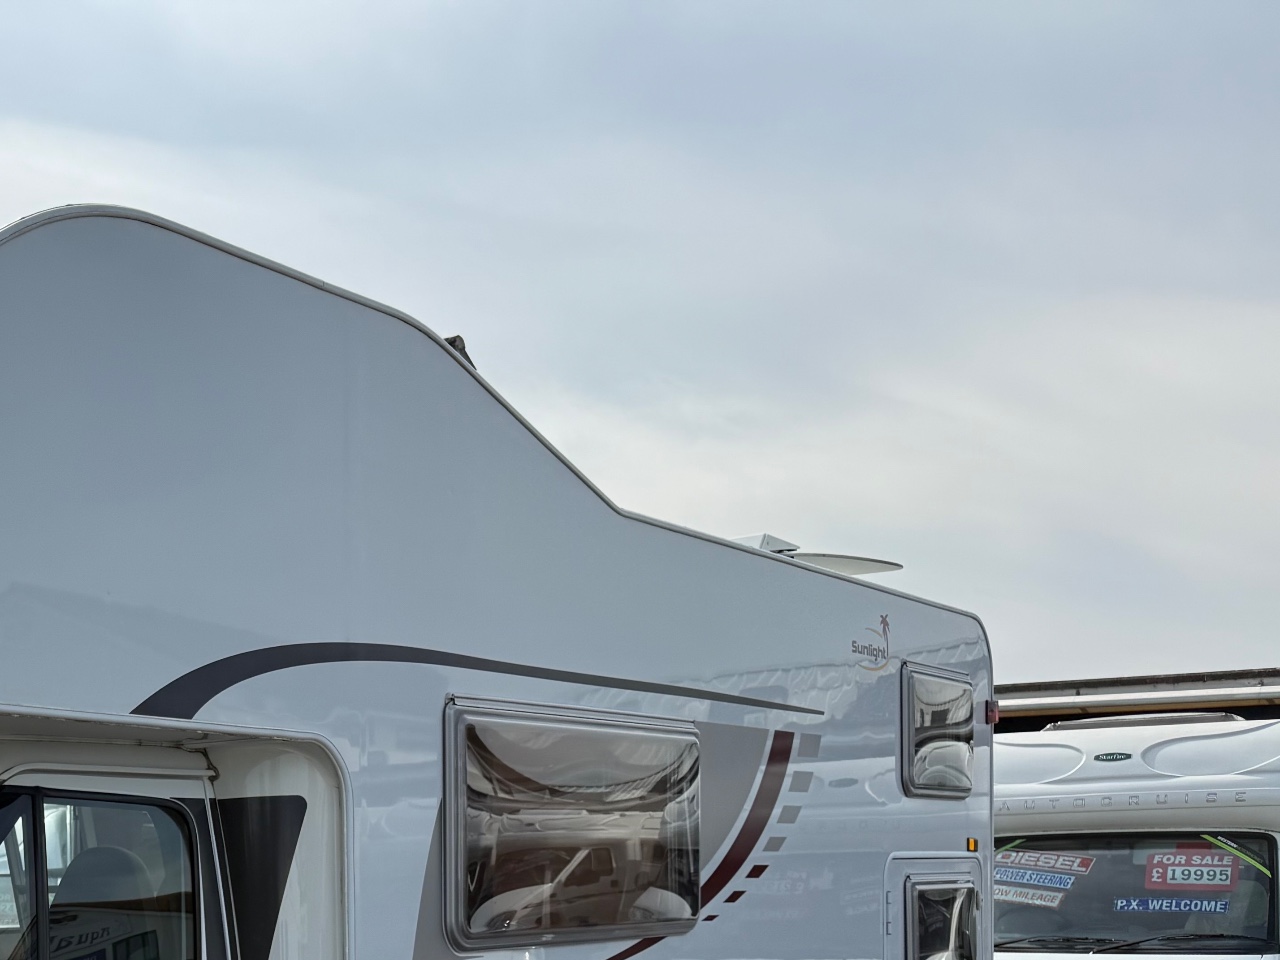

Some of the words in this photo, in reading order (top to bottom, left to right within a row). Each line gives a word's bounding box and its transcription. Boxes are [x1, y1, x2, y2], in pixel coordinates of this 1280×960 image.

[851, 639, 887, 662] Sunlight
[995, 850, 1087, 872] DIESEL
[1153, 854, 1187, 864] FOR
[1191, 855, 1234, 865] SALE
[994, 868, 1027, 881] POWER
[1026, 872, 1072, 888] STEERING
[1011, 889, 1059, 904] MILEAGE
[1116, 899, 1143, 911] P.X.
[1148, 900, 1226, 912] WELCOME
